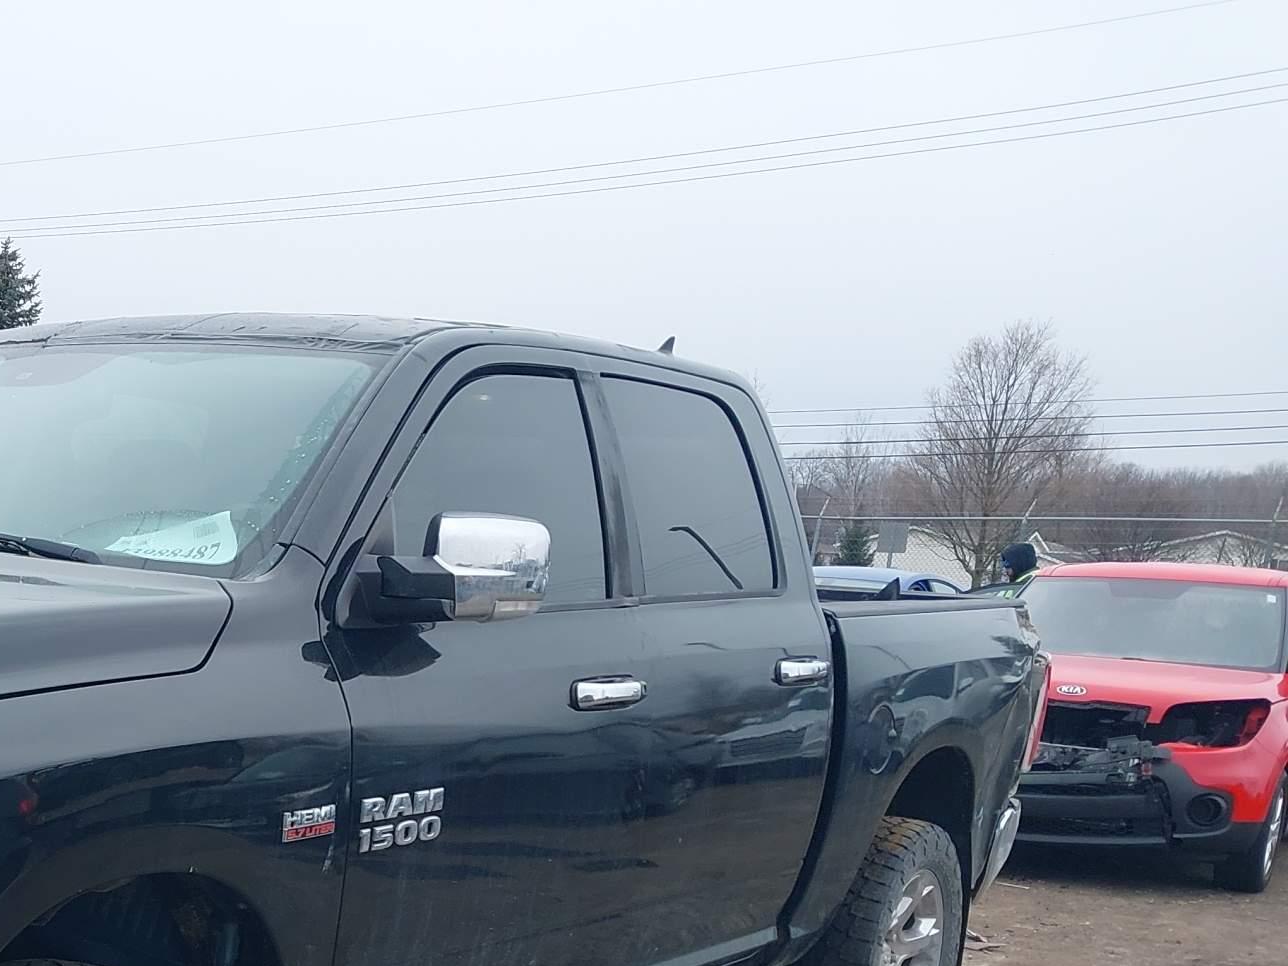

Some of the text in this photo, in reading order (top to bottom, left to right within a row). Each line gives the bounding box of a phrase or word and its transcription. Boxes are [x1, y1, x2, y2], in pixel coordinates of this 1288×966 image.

[283, 804, 336, 828] HEMI
[360, 787, 445, 823] RAM
[359, 815, 441, 853] 1500
